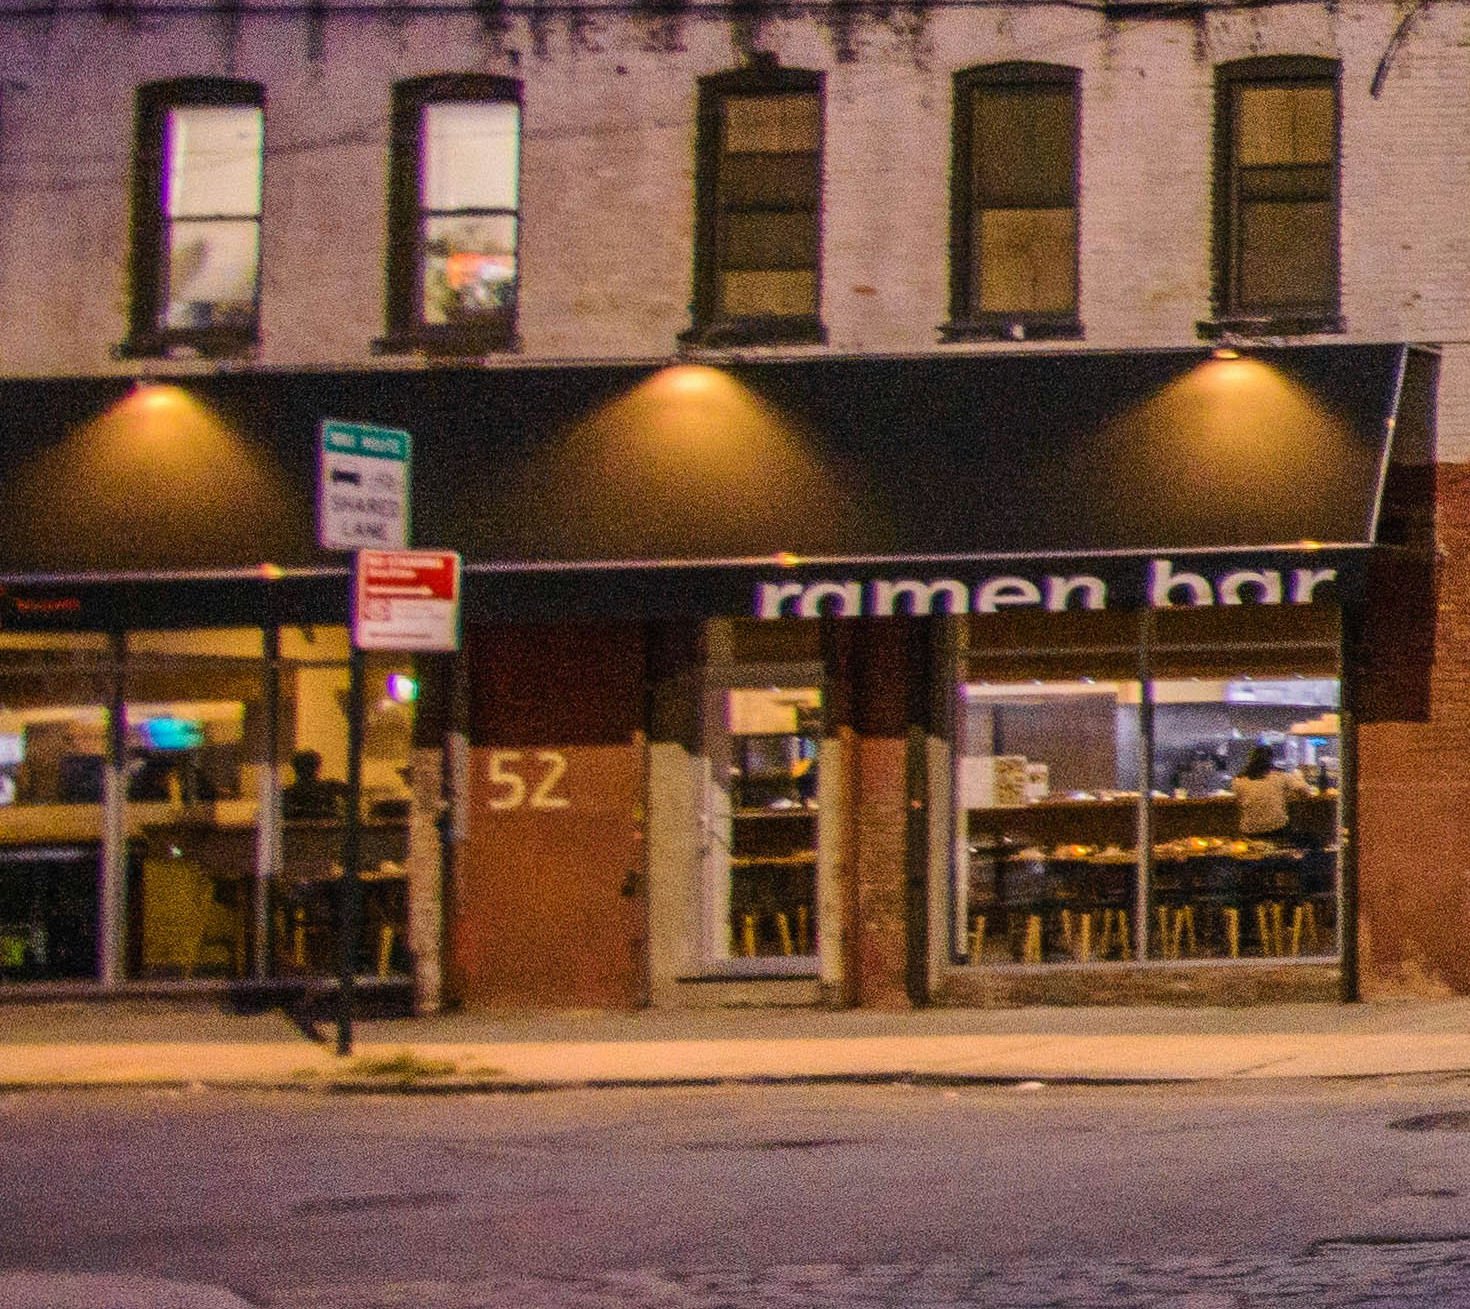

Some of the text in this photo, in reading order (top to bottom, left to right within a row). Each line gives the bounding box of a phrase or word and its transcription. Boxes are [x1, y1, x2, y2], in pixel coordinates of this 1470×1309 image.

[758, 558, 1338, 620] ramen bar
[489, 750, 571, 811] 52
